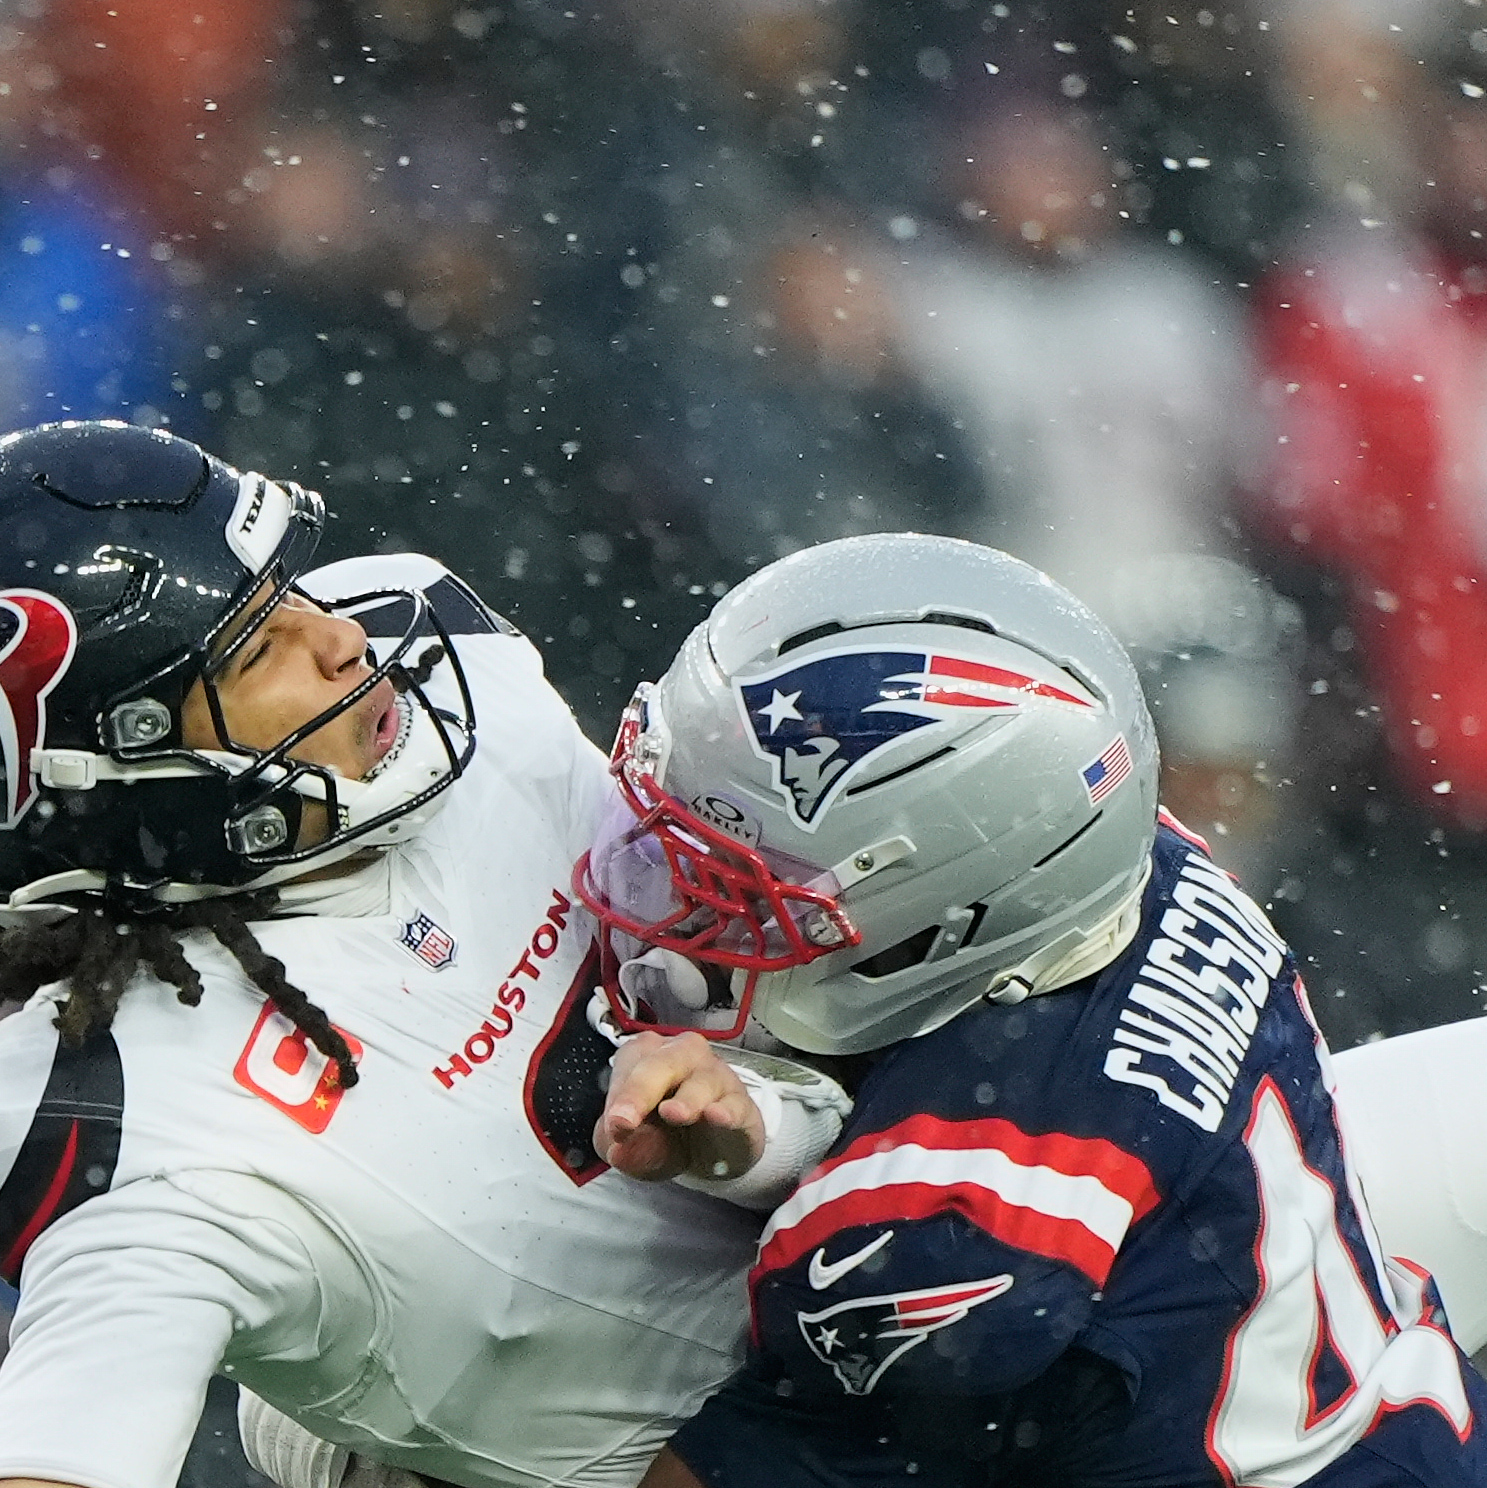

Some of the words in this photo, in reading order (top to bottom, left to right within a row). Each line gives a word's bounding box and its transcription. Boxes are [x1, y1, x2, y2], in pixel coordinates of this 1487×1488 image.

[419, 932, 450, 964] NFL
[431, 888, 572, 1090] HOUSTON
[1102, 852, 1288, 1133] CHAISSON
